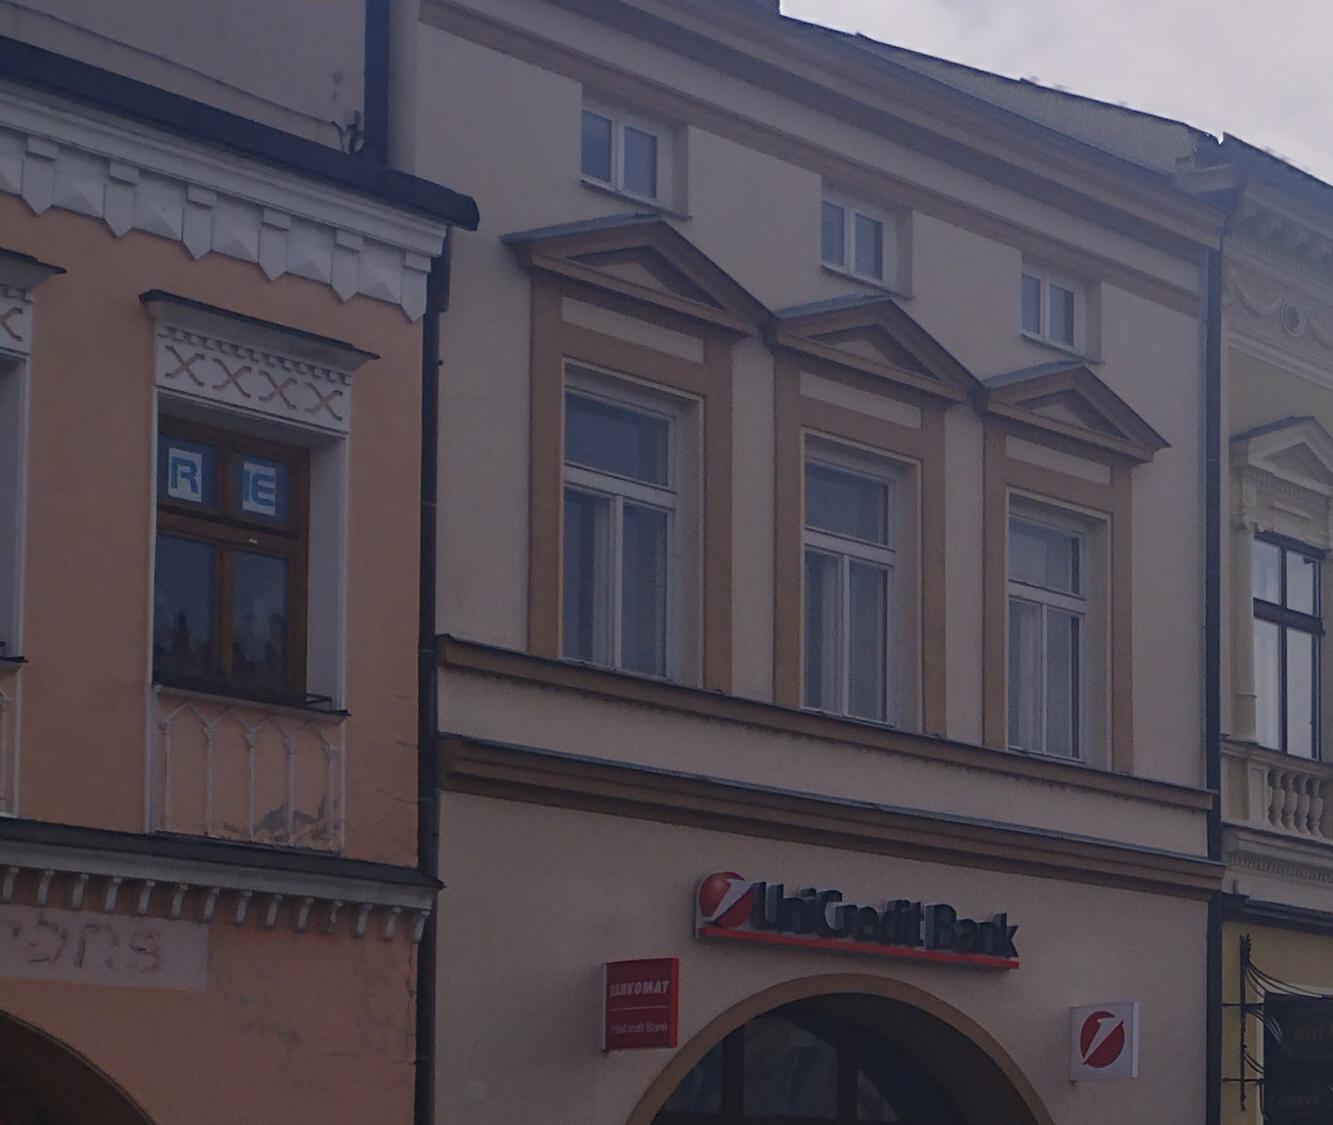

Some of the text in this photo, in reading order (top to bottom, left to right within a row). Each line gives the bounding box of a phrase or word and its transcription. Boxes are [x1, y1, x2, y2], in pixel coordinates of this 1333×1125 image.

[750, 881, 1019, 958] UniCredit Bank
[608, 980, 670, 998] BANKOMAT
